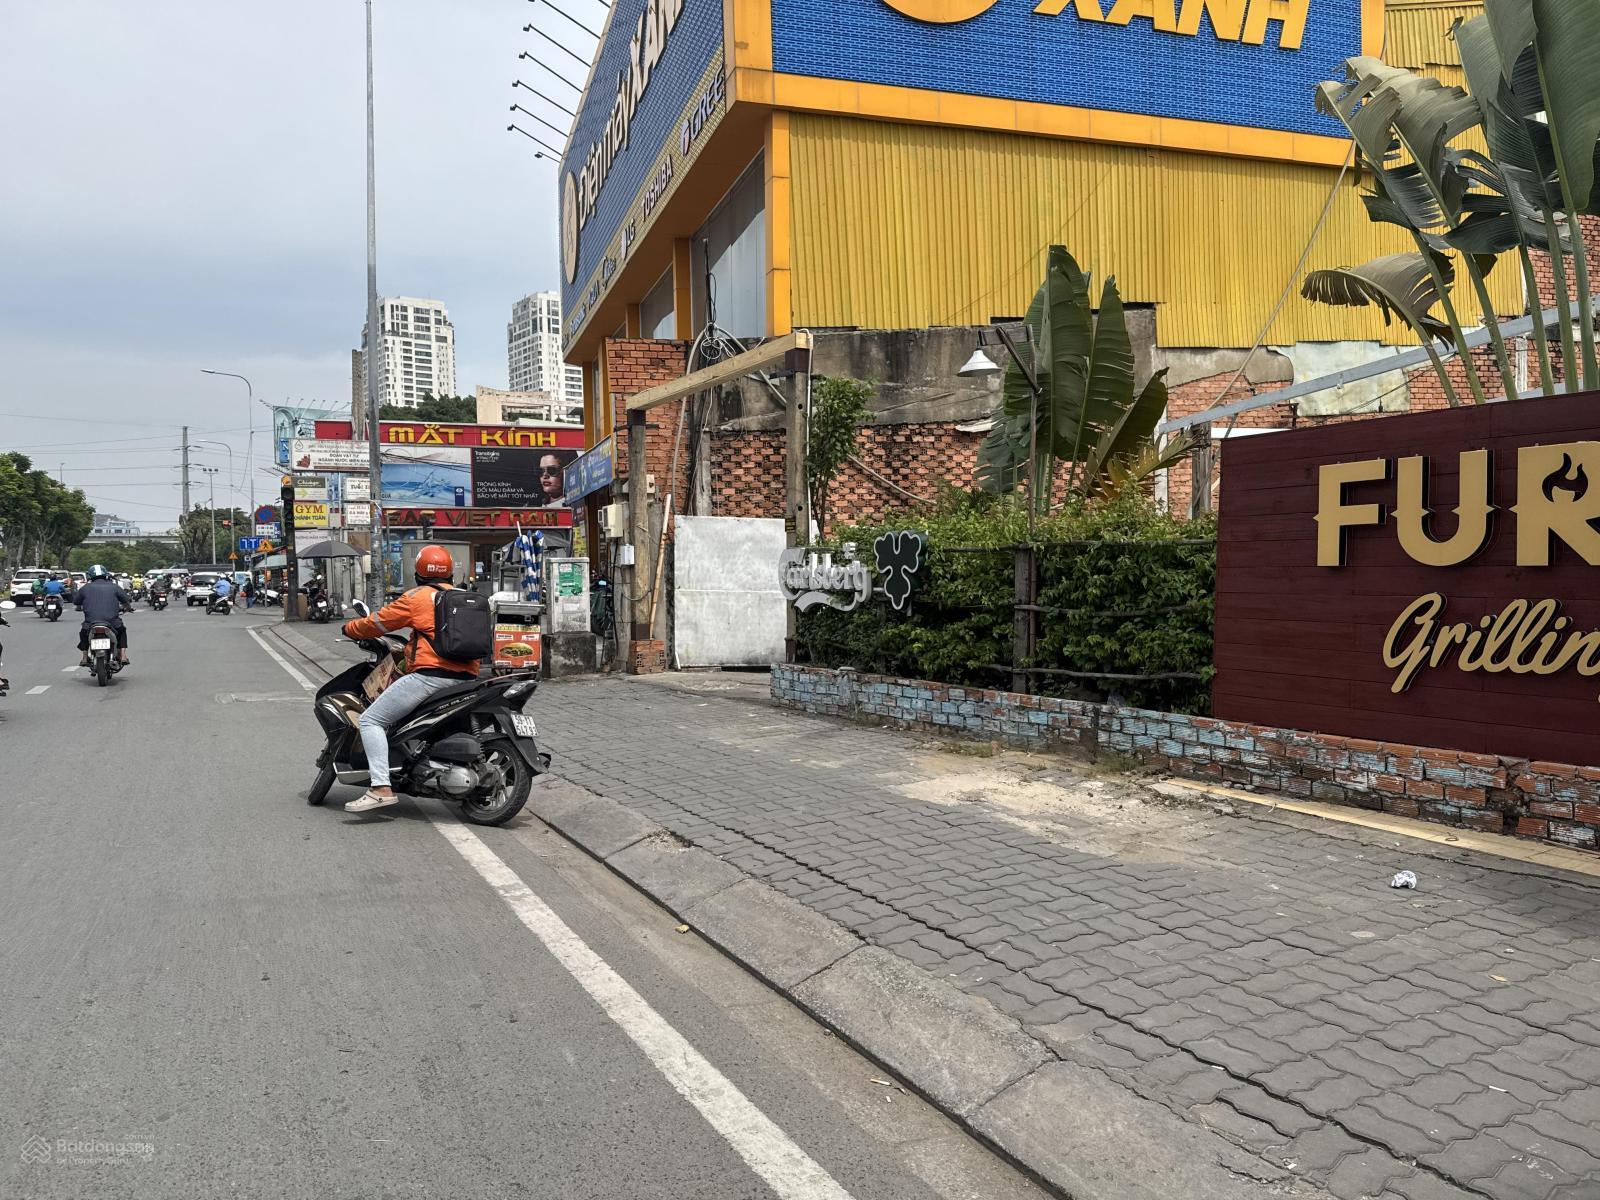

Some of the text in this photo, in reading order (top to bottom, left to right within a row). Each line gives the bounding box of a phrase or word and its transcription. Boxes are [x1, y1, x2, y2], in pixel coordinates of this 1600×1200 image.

[691, 65, 724, 141] GREE
[642, 155, 674, 222] TOSHIBA
[388, 423, 557, 447] MẮT KÍNH
[295, 504, 324, 514] GYM
[1313, 441, 1600, 566] FUR
[778, 547, 872, 612] Carlsberg
